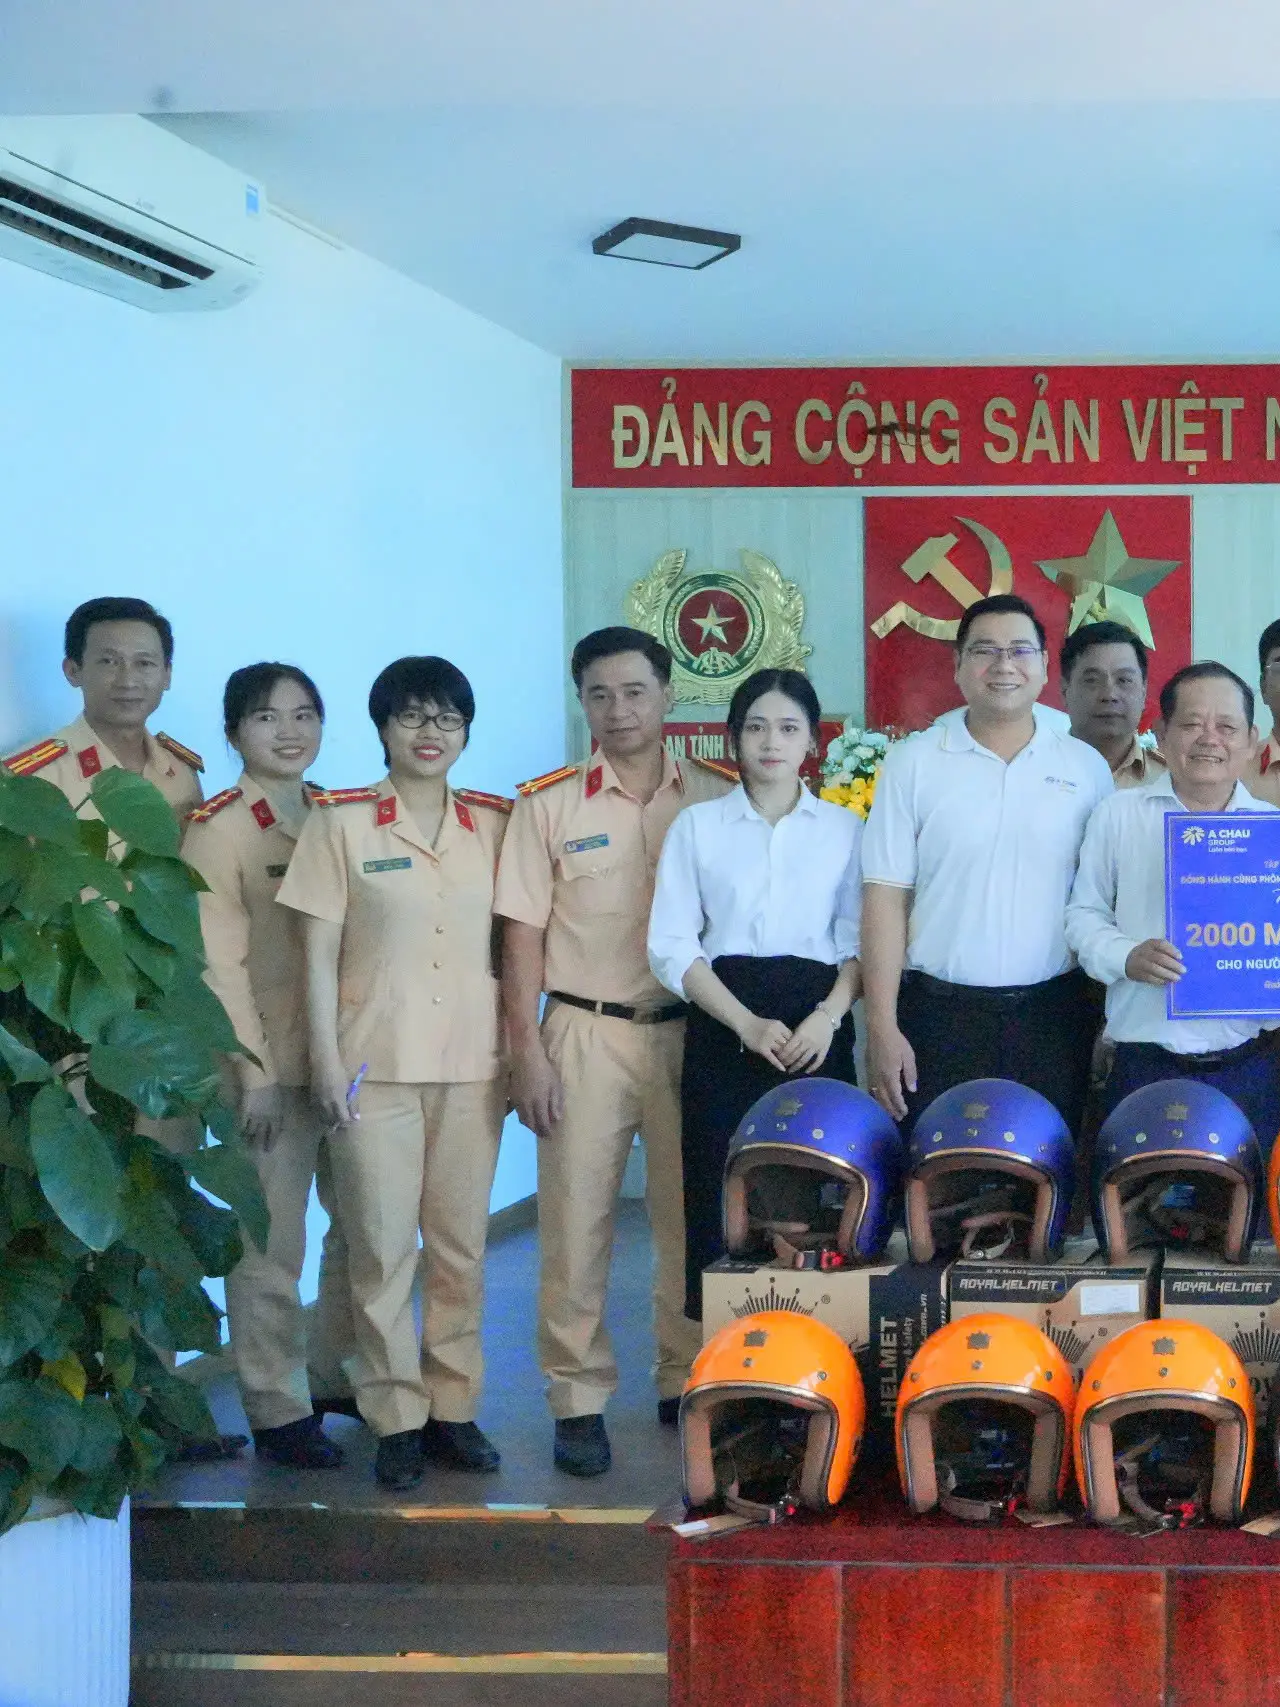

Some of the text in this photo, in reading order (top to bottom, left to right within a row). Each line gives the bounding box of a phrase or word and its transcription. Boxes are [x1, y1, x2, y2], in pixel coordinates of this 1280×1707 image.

[611, 377, 772, 470] ĐẢNG
[795, 382, 961, 479] CỘNG
[983, 373, 1100, 467] SẢN
[1122, 380, 1245, 476] VIỆT
[689, 725, 725, 760] TỈNH
[1185, 922, 1256, 948] 2000
[1216, 959, 1243, 970] CHO
[959, 1279, 1058, 1292] ROYALHELMET
[1172, 1281, 1273, 1294] ROYALHELMET
[880, 1316, 898, 1418] HELMET
